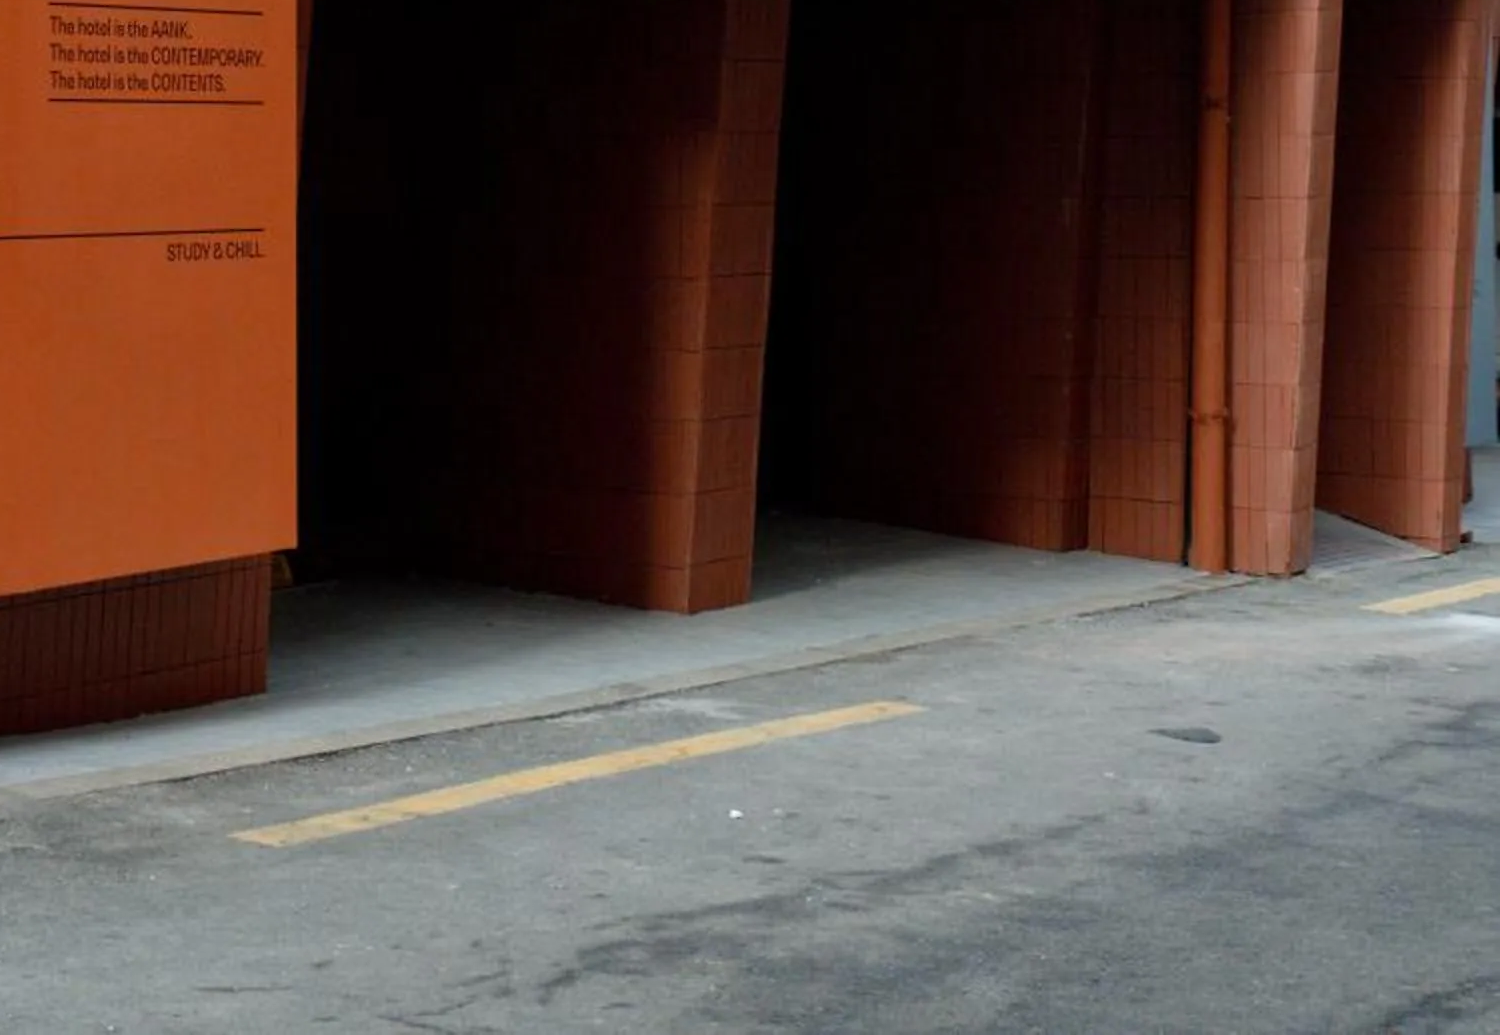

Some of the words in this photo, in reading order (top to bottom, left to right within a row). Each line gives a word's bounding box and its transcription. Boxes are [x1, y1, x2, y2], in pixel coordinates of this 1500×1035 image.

[50, 16, 75, 35] The
[78, 17, 111, 37] hotel
[114, 19, 125, 37] is
[127, 20, 149, 39] the
[50, 43, 75, 63] The
[78, 44, 111, 64] hotel
[114, 45, 125, 64] is
[127, 46, 149, 65] the
[50, 71, 75, 90] The
[78, 71, 111, 91] hotel
[114, 72, 125, 91] is
[127, 72, 149, 91] the
[167, 242, 211, 262] STUDY
[213, 242, 223, 260] &
